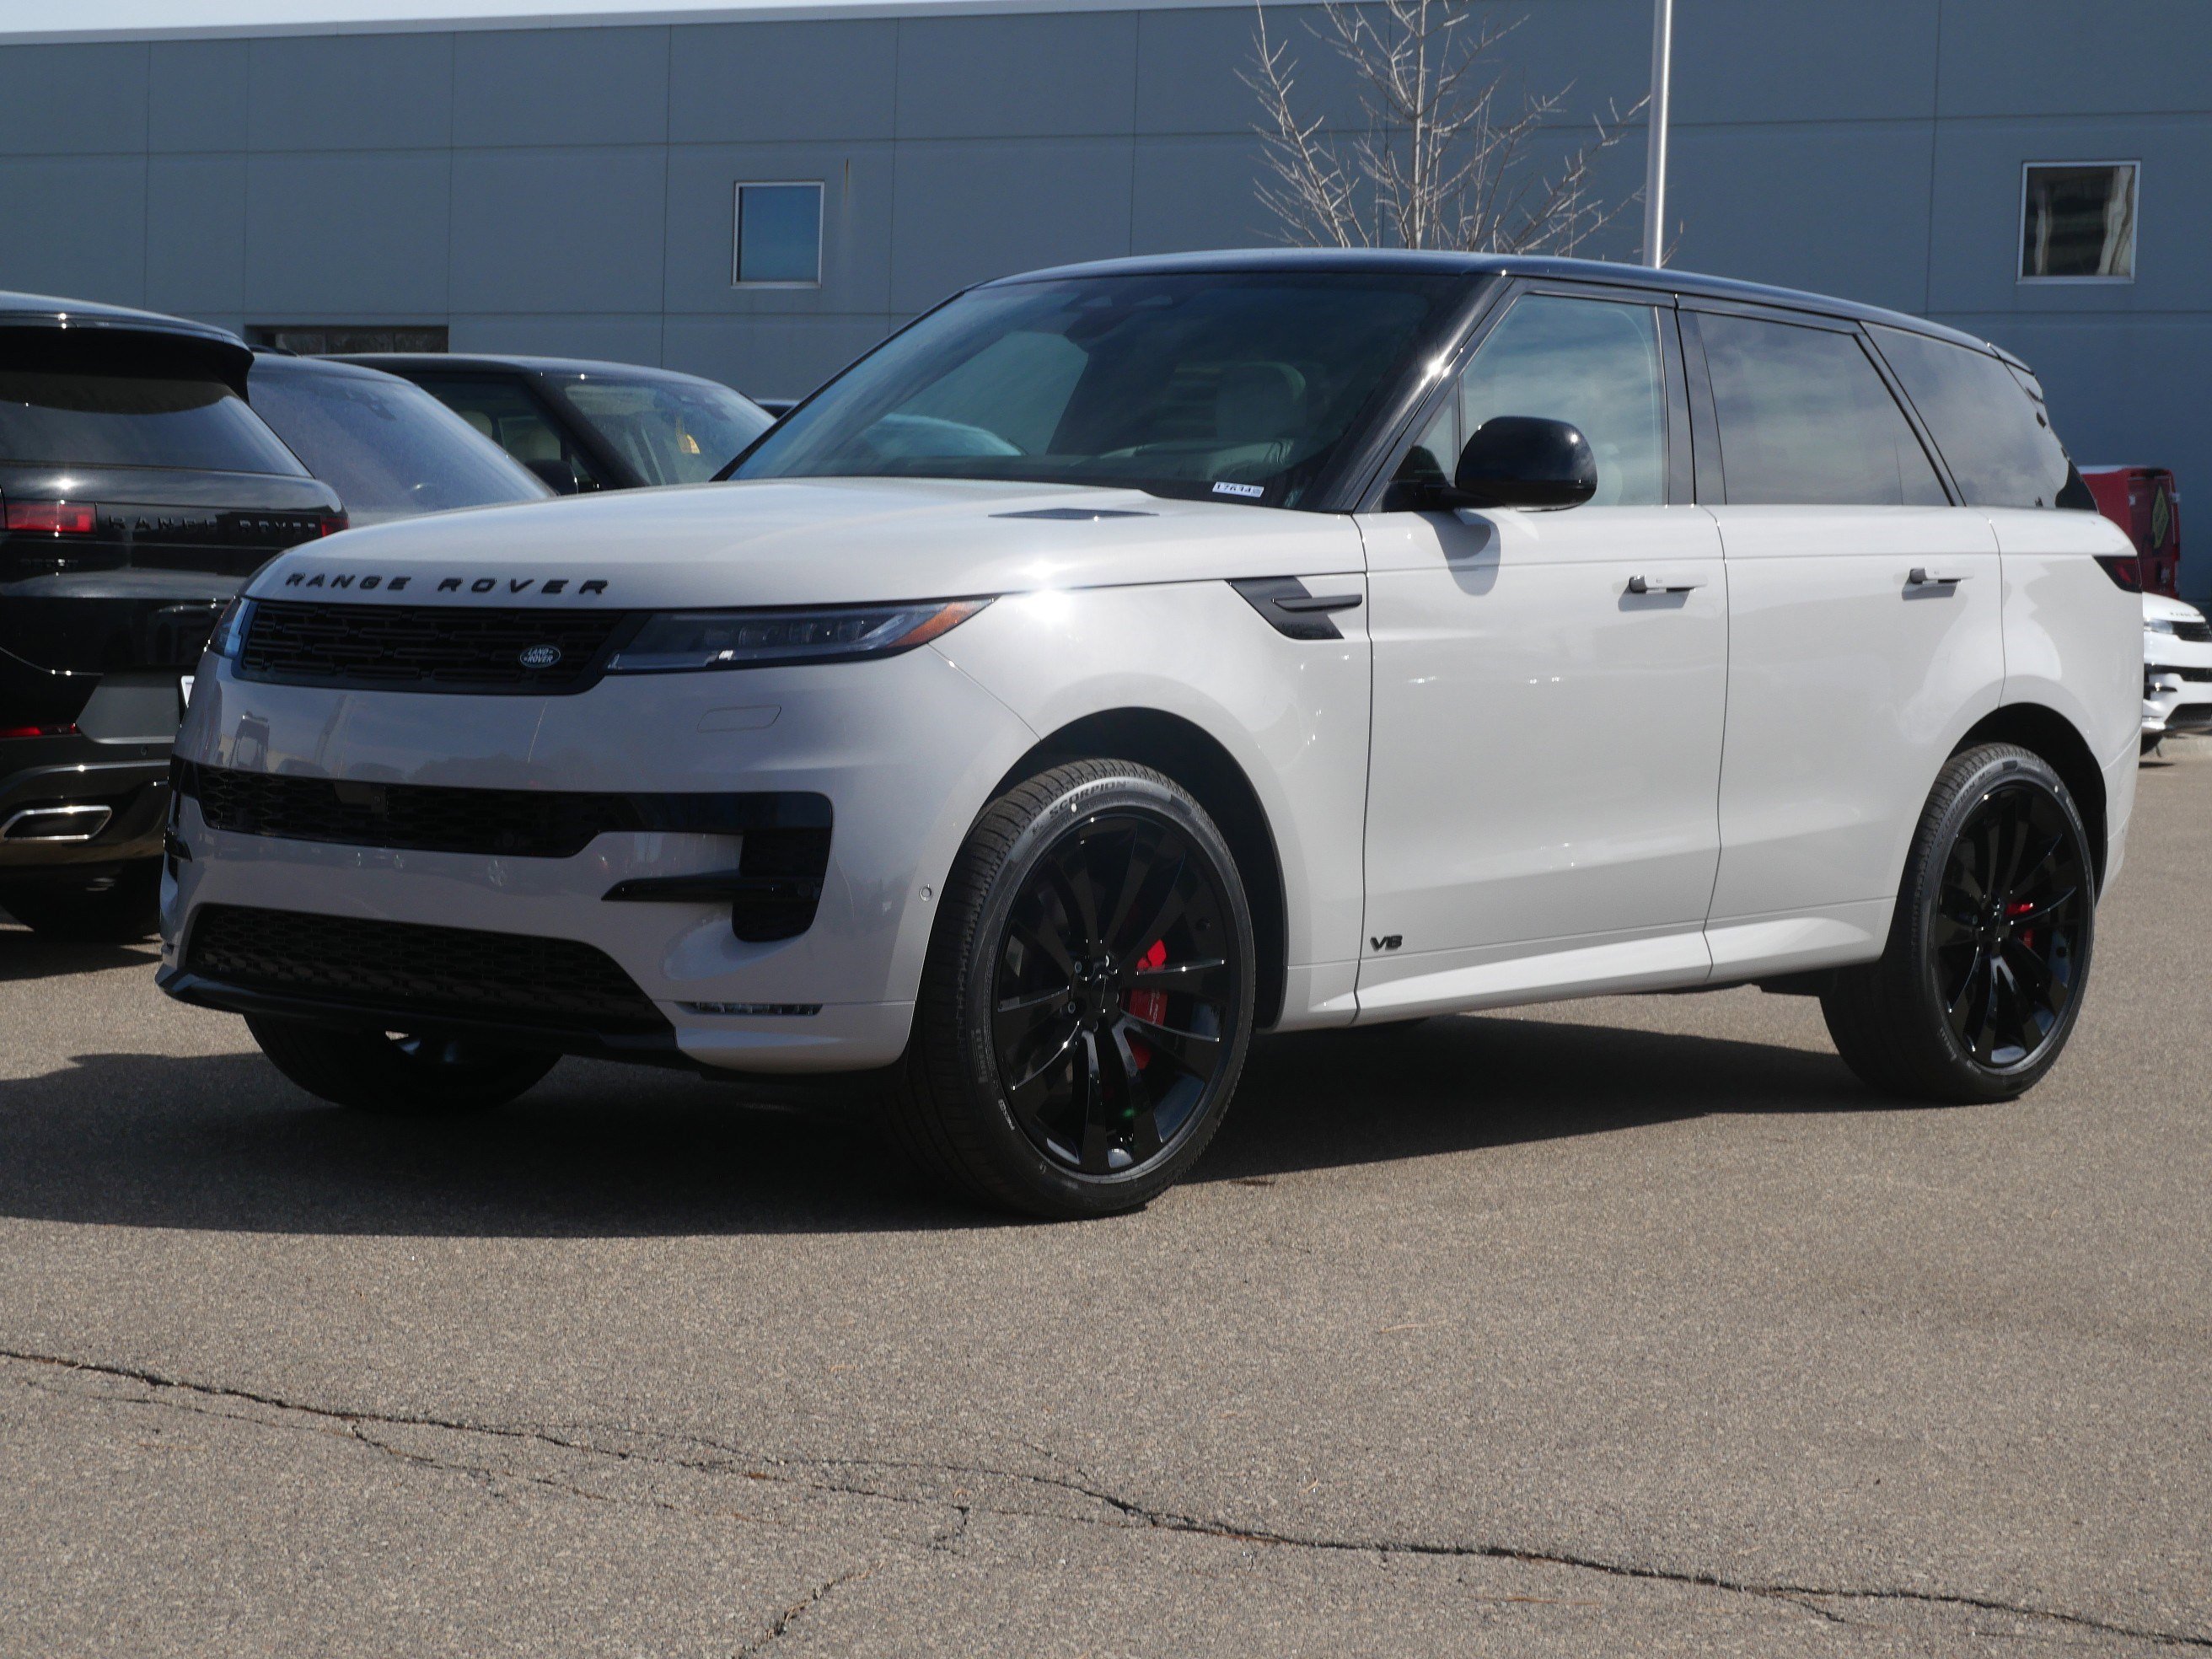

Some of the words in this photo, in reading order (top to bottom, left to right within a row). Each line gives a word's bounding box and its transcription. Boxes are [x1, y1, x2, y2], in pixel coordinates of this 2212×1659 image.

[285, 572, 412, 591] RANGE
[437, 577, 609, 595] ROVER
[527, 654, 554, 664] ROVER
[1049, 781, 1128, 820] SCORPION
